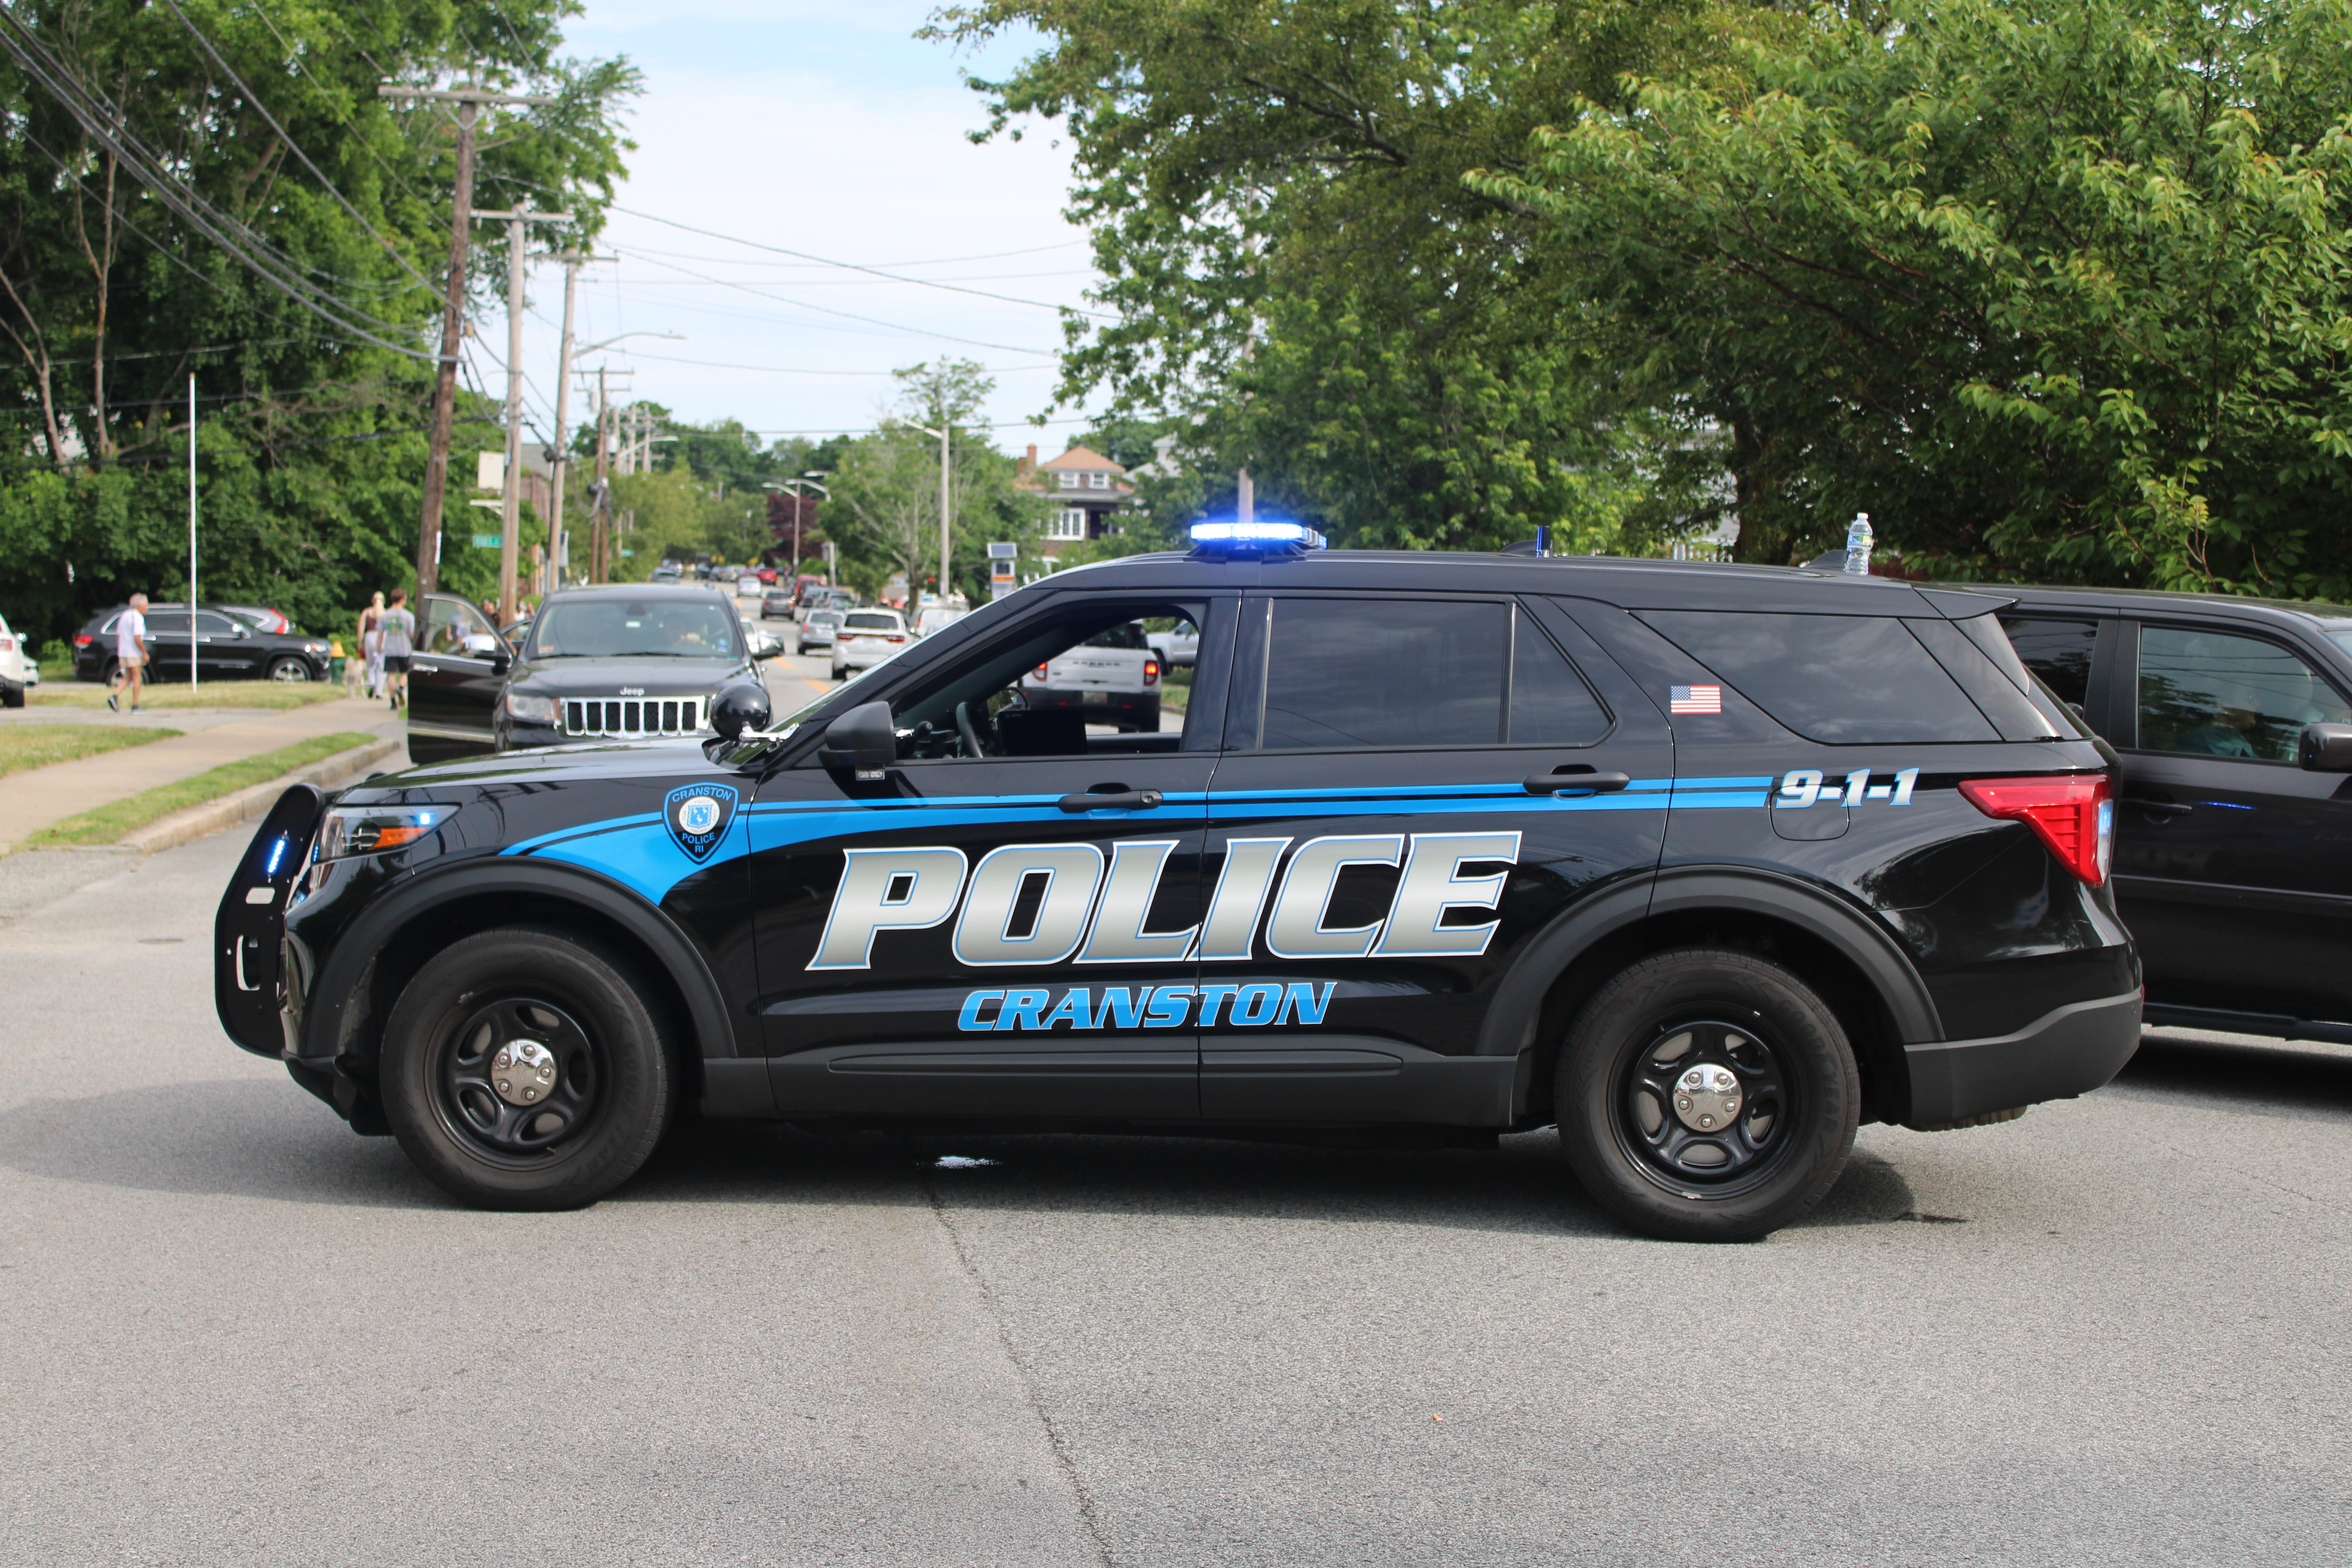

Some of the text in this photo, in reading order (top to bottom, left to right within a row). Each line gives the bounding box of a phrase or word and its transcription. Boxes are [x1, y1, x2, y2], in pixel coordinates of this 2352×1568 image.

[620, 686, 645, 696] Jeep
[672, 786, 732, 802] CRANSTON
[1776, 767, 1920, 808] 9-1-1
[682, 832, 715, 844] POLICE
[804, 831, 1523, 971] POLICE
[958, 982, 1338, 1032] CRANSTON
[1776, 998, 1840, 1134] GOODYEAR
